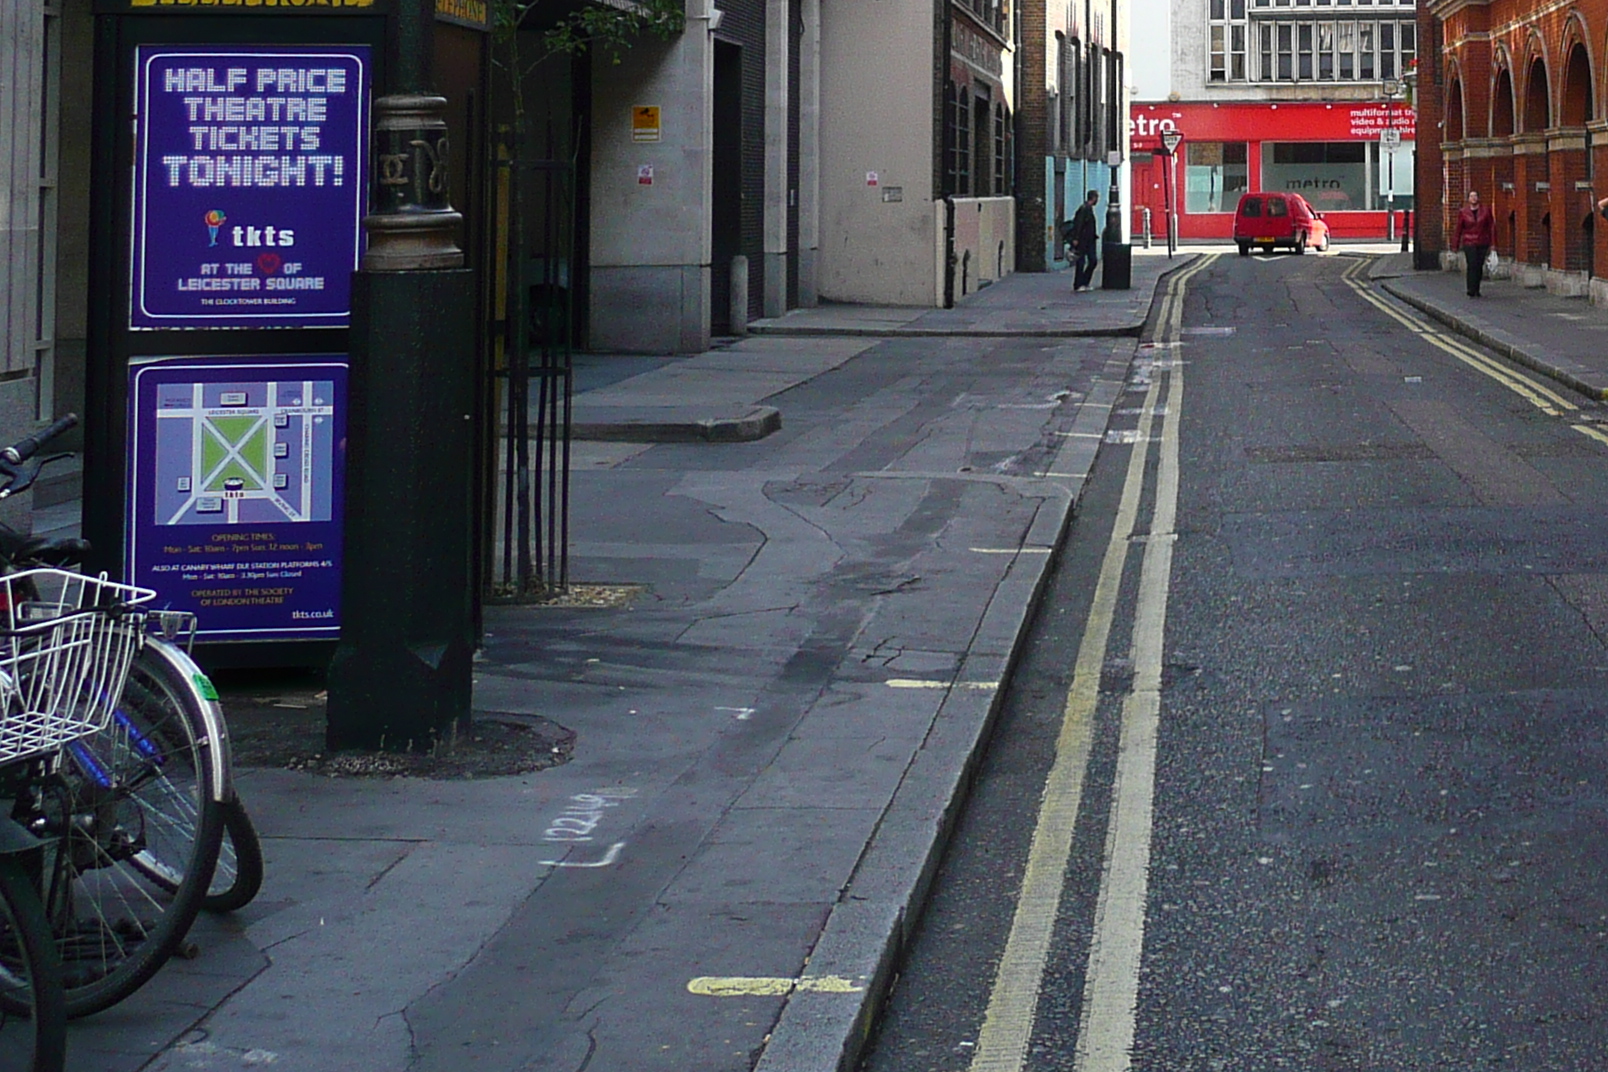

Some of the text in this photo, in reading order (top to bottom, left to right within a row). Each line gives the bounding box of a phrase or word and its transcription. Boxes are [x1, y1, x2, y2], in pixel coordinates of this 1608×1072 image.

[165, 68, 346, 93] HALF PRICE
[184, 97, 327, 121] THEATRE
[189, 126, 320, 150] TICKETS
[163, 156, 343, 187] TONIGHT!
[1286, 176, 1340, 188] metro
[232, 226, 295, 247] tkts
[201, 263, 302, 275] AT THE OF
[178, 277, 324, 291] LEICESTER SQUARE
[264, 297, 296, 305] BUILDING
[212, 534, 249, 542] OPENING
[164, 545, 182, 553] Mon
[192, 589, 230, 597] OPERATED
[213, 598, 250, 606] LONDON
[292, 609, 334, 619] tkts.co.uk
